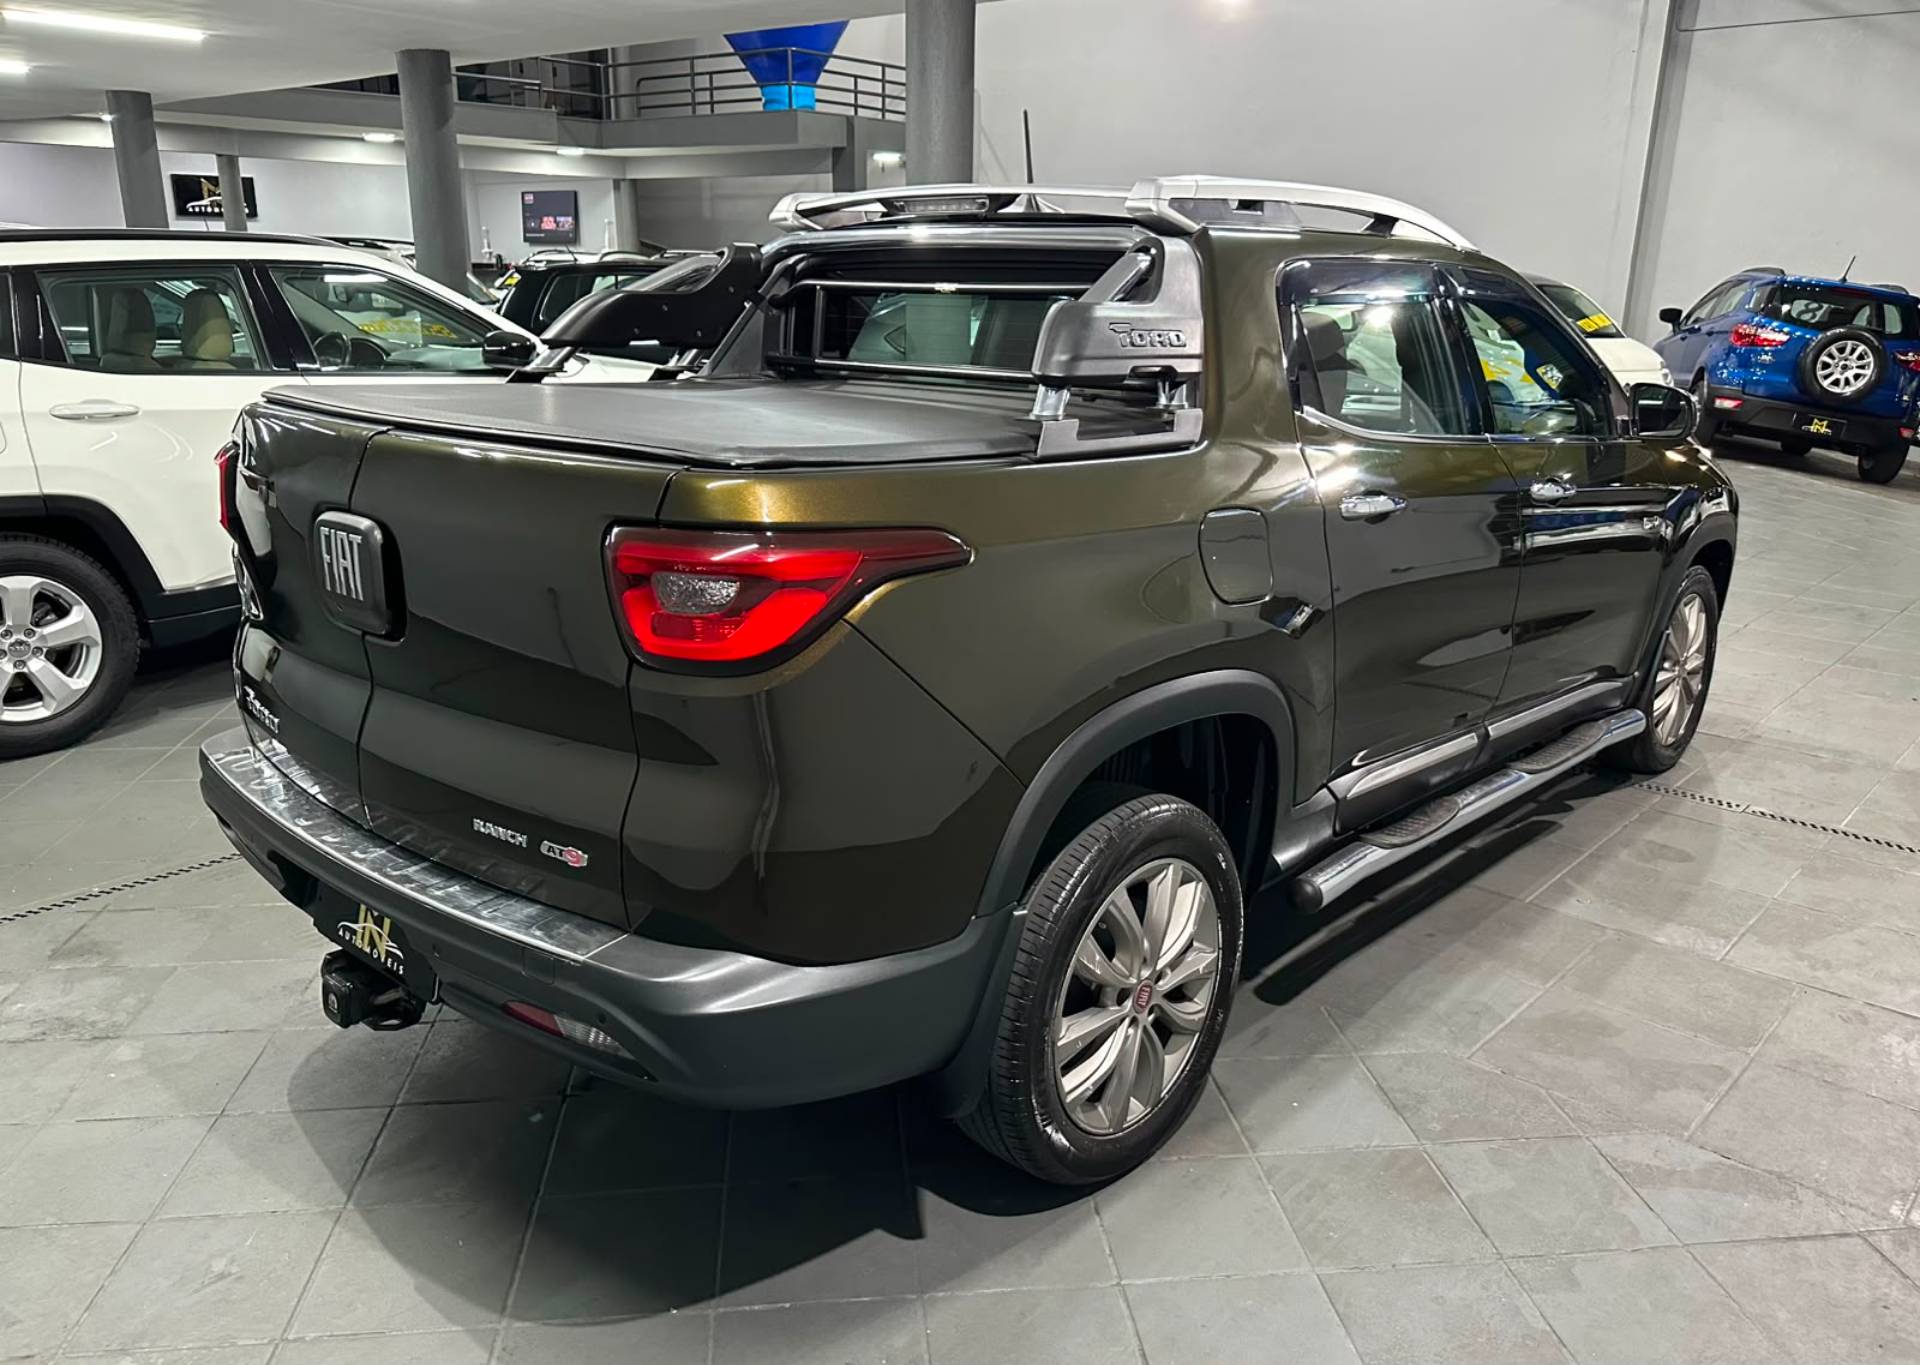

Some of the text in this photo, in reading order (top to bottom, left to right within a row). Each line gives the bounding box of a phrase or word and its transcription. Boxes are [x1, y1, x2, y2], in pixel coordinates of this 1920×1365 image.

[1108, 322, 1187, 348] TORO
[320, 526, 364, 601] FIAT
[473, 818, 528, 848] RANCH
